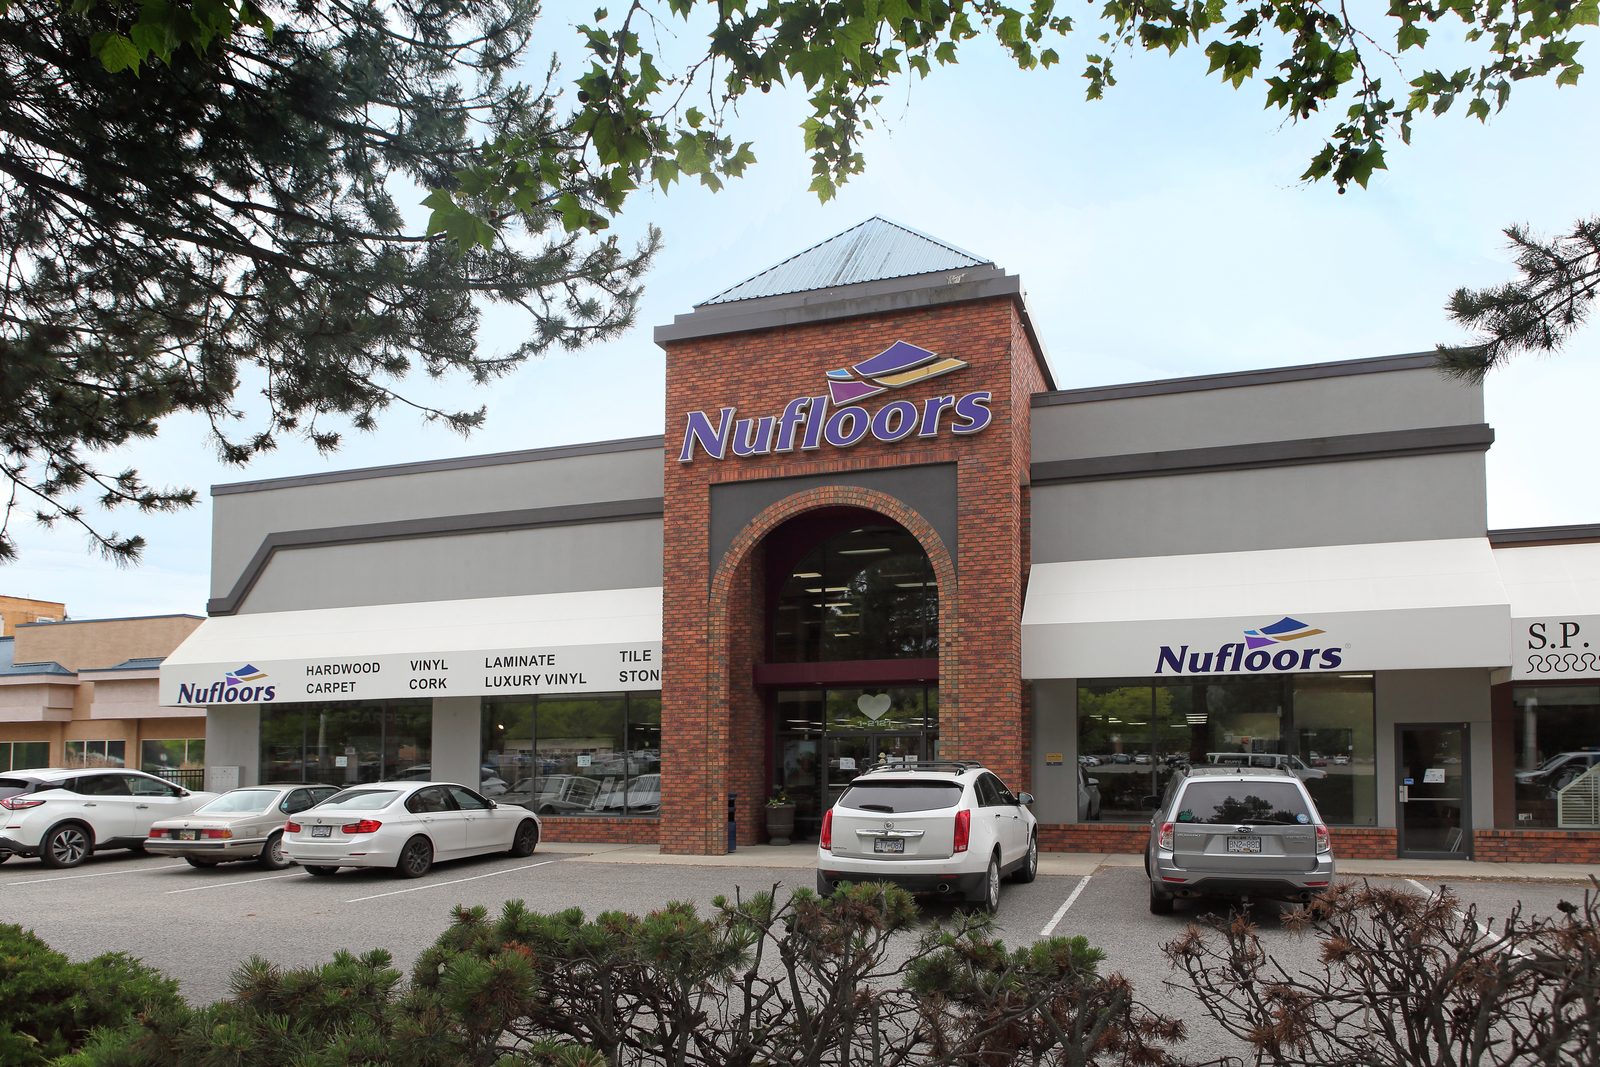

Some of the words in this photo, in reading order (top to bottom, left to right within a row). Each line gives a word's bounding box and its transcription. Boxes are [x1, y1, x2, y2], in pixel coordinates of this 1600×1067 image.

[678, 392, 992, 463] Nufloors
[1528, 622, 1590, 650] S.P.
[485, 654, 555, 668] LAMINATE
[619, 649, 652, 662] TILE
[1155, 642, 1342, 674] Nufloors
[306, 662, 381, 676] HARDWOOD
[410, 659, 449, 671] VINYL
[485, 674, 541, 687] LUXURY
[545, 672, 587, 685] VINYL
[619, 669, 660, 682] STON
[306, 681, 357, 694] CARPET
[409, 678, 447, 690] CORK
[177, 682, 276, 704] Nufloors
